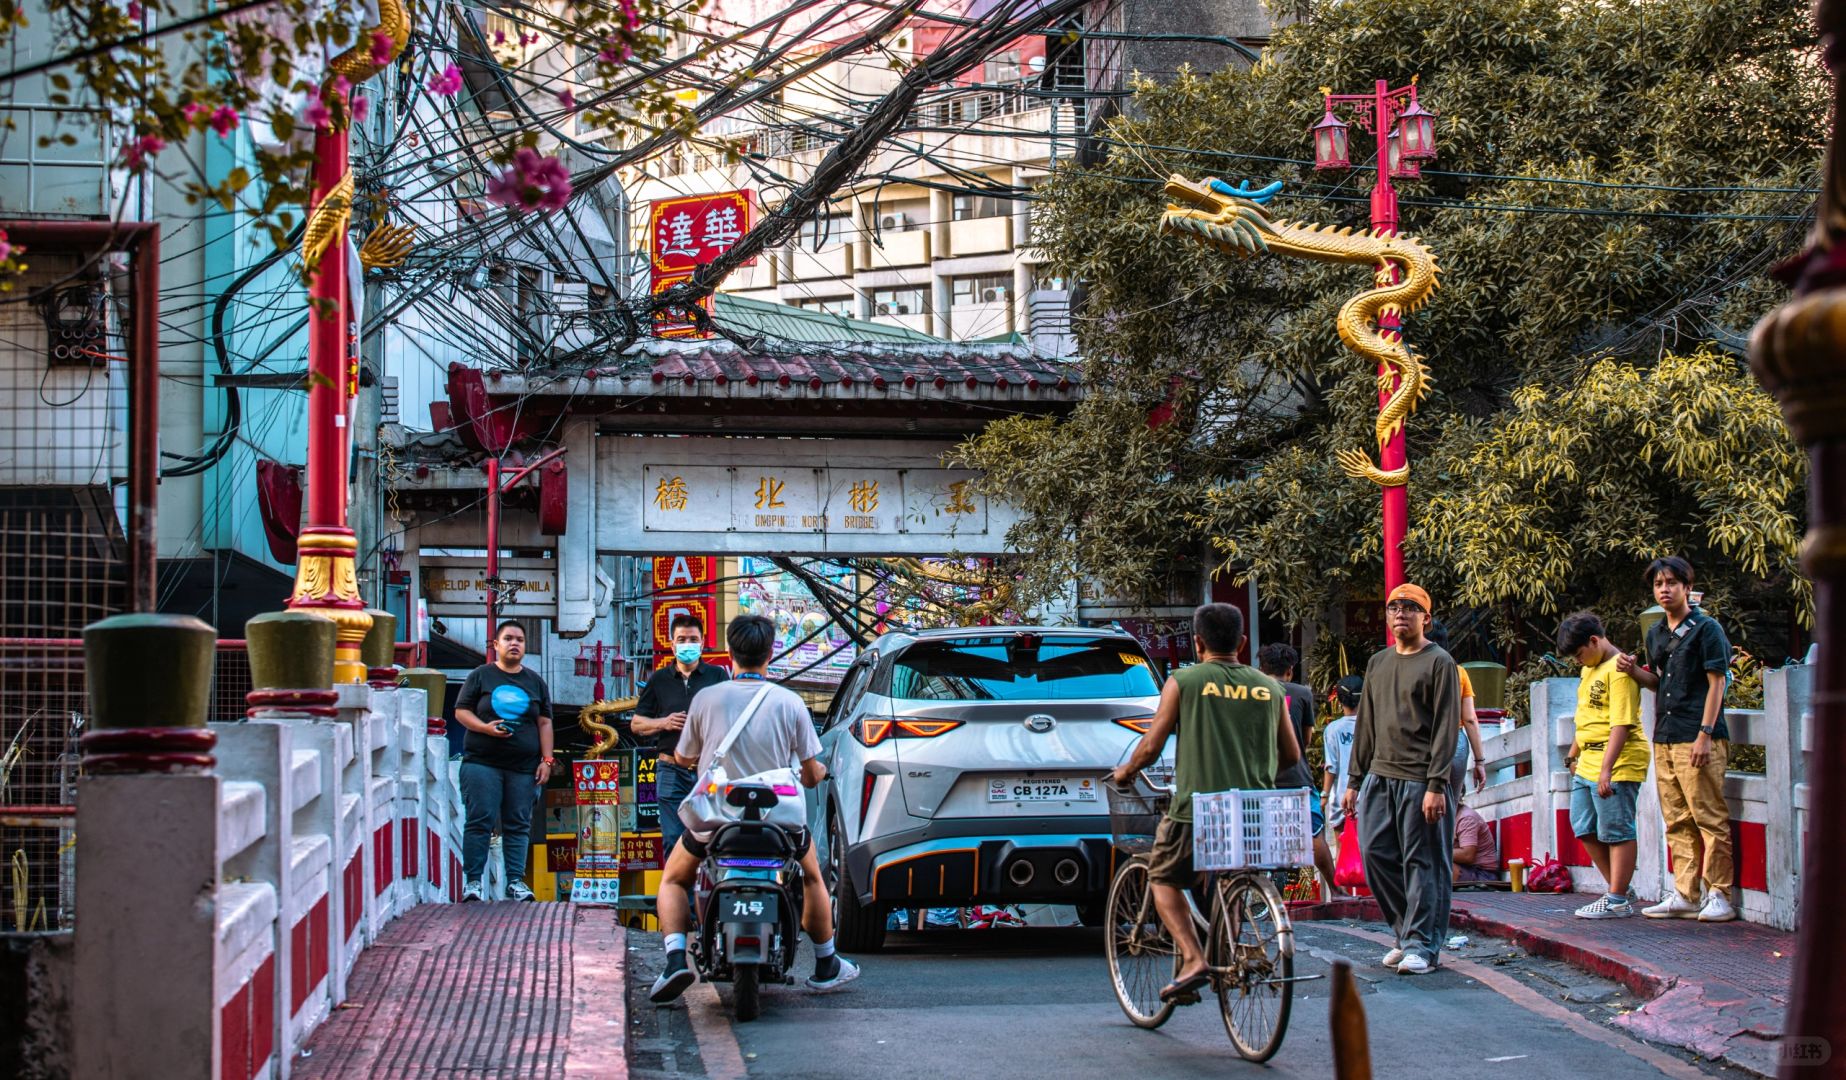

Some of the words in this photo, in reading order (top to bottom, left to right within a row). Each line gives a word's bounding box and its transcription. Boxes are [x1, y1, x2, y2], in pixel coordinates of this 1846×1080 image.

[755, 514, 785, 528] ONGPIN
[1201, 681, 1271, 701] AMG
[1013, 785, 1032, 796] CB
[1035, 785, 1068, 796] 127A
[733, 900, 764, 915] 九号
